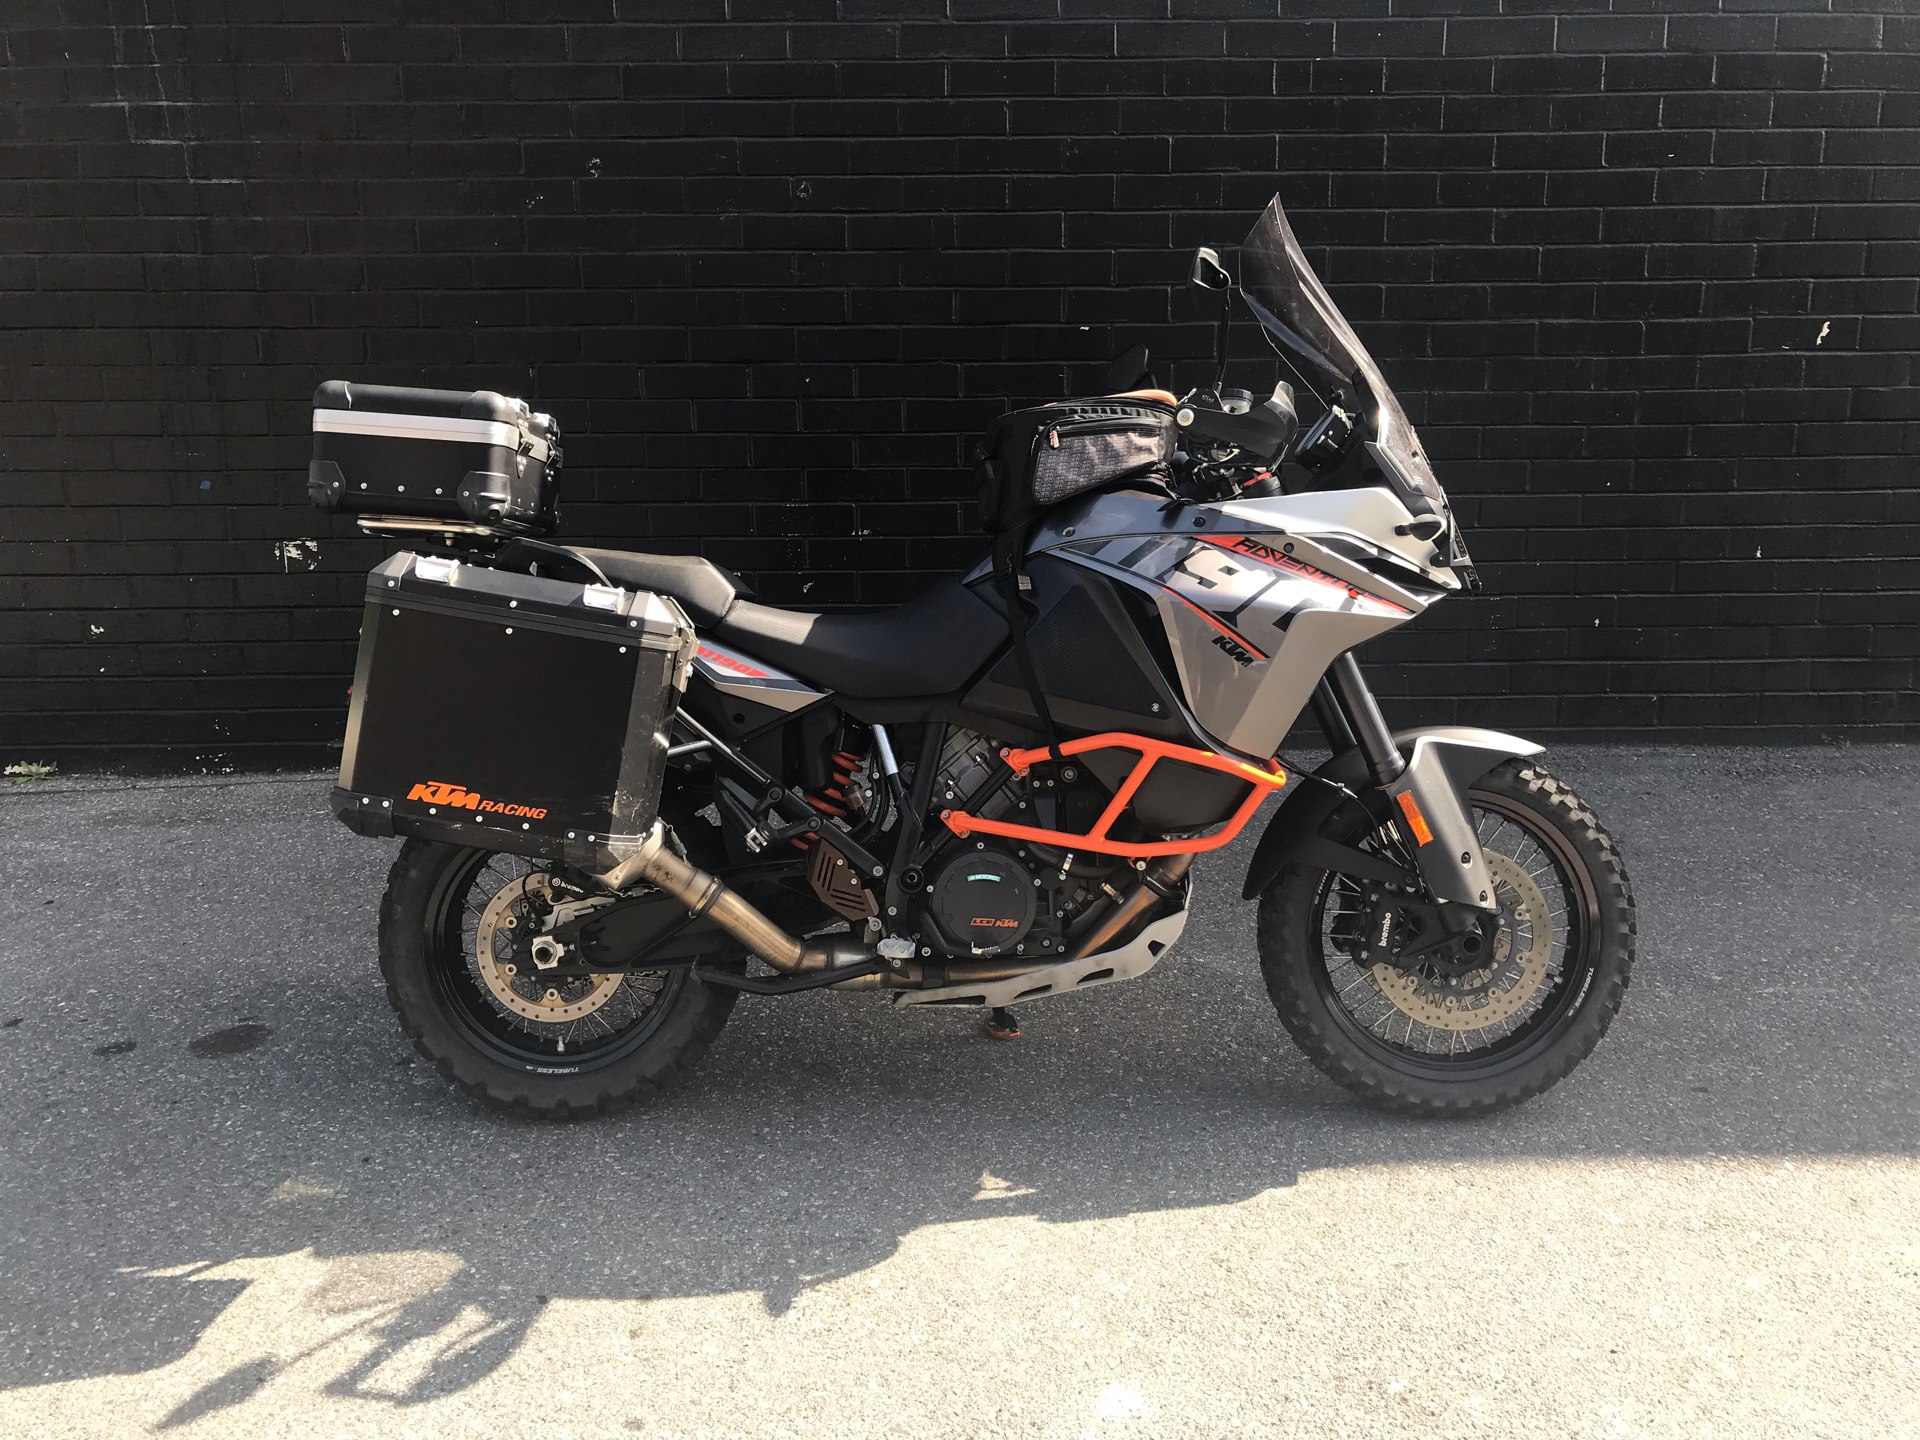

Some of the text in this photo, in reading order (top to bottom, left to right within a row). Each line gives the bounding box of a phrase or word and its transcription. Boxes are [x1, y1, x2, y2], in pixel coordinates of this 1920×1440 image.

[1211, 634, 1254, 668] KTM
[406, 780, 548, 820] KTM RACING
[995, 918, 1019, 927] KTM
[1377, 912, 1392, 947] brembo
[1574, 967, 1595, 1008] TUBELESS
[536, 1066, 579, 1074] TUBELESS
